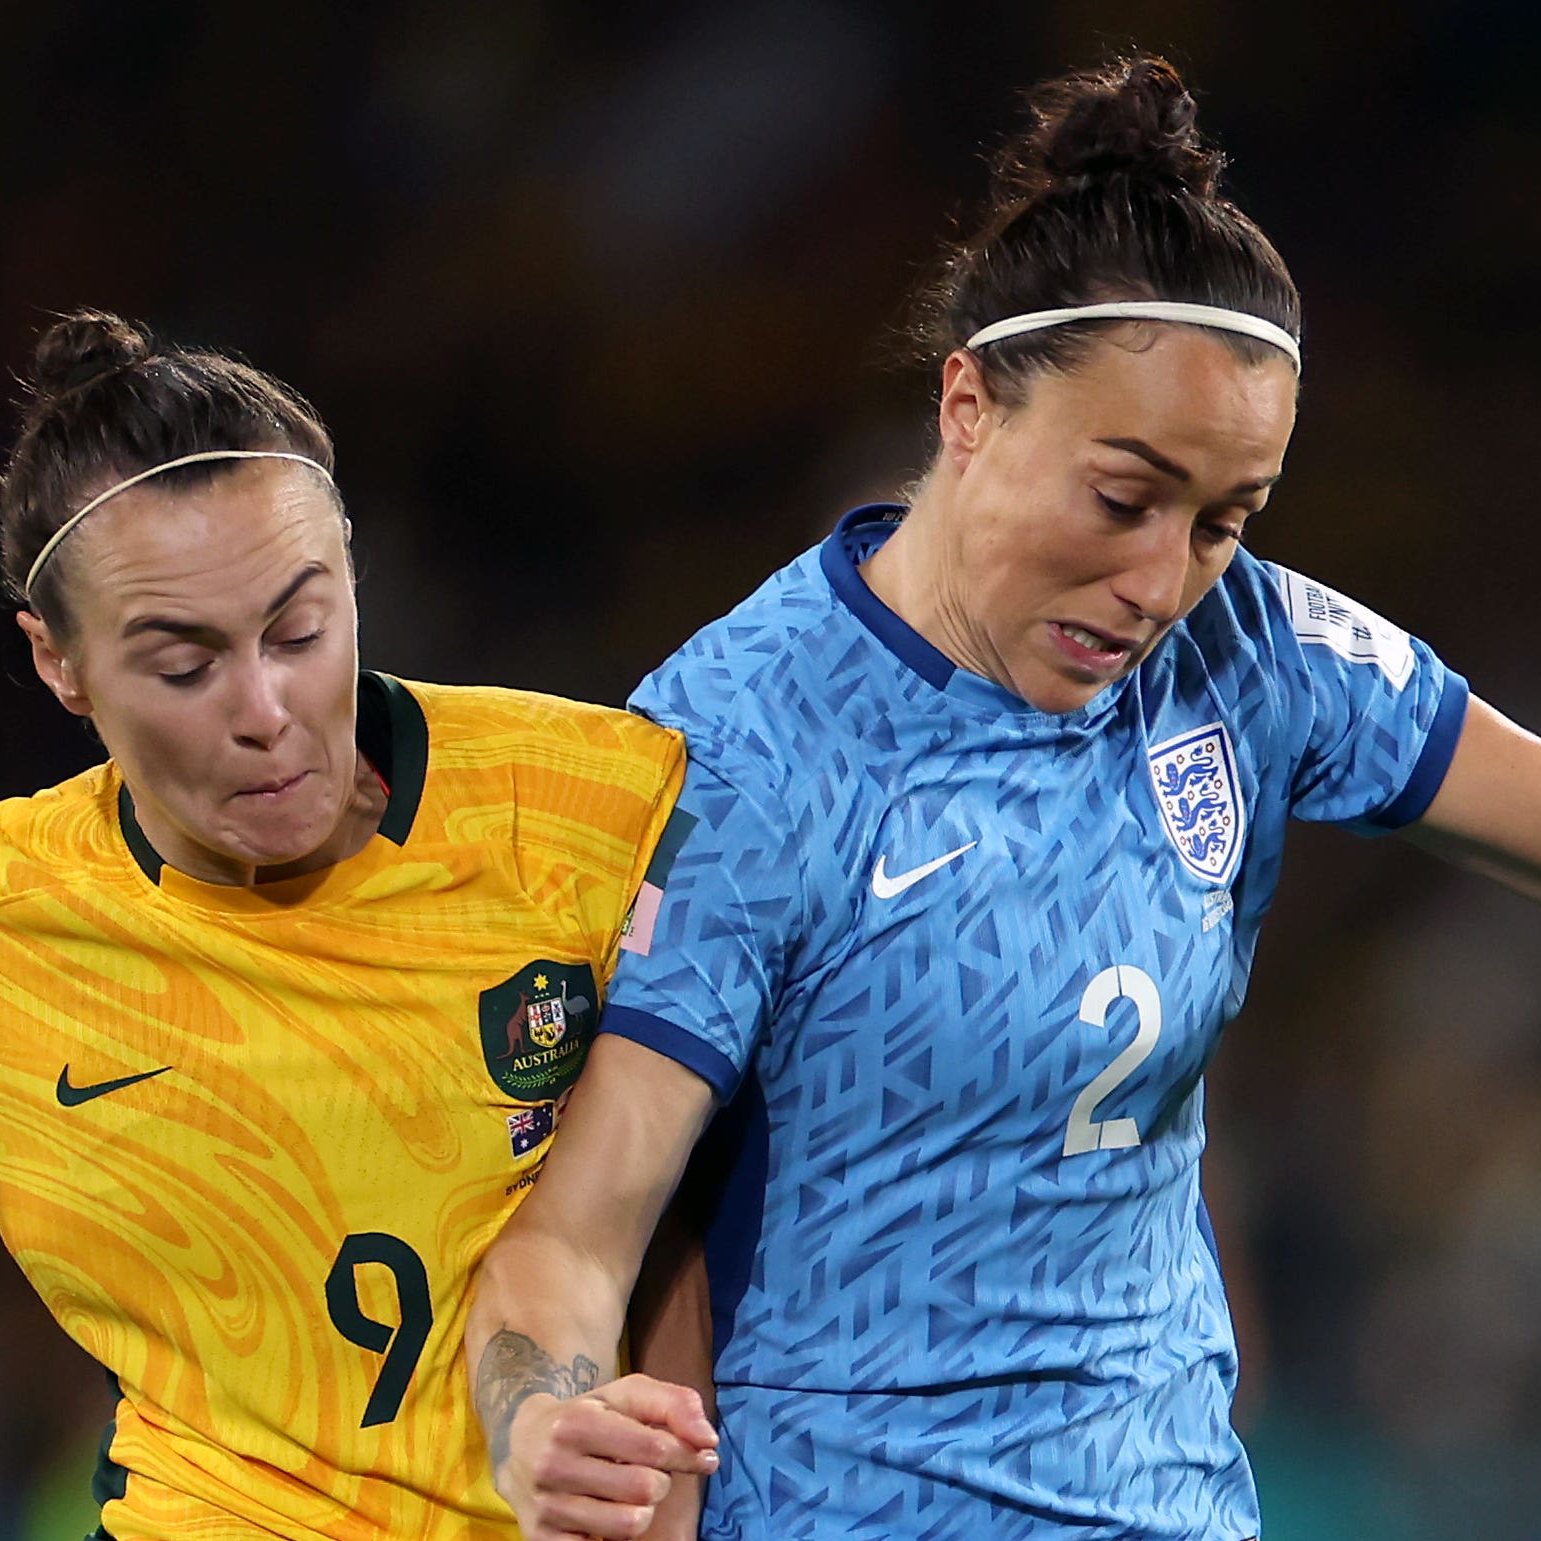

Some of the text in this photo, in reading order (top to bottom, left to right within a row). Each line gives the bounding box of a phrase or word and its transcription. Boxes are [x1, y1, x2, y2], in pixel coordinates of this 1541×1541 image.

[1325, 595, 1351, 629] UNIT
[512, 1040, 579, 1071] AUSTRALIA
[1062, 964, 1162, 1157] 2
[325, 1232, 434, 1428] 9
